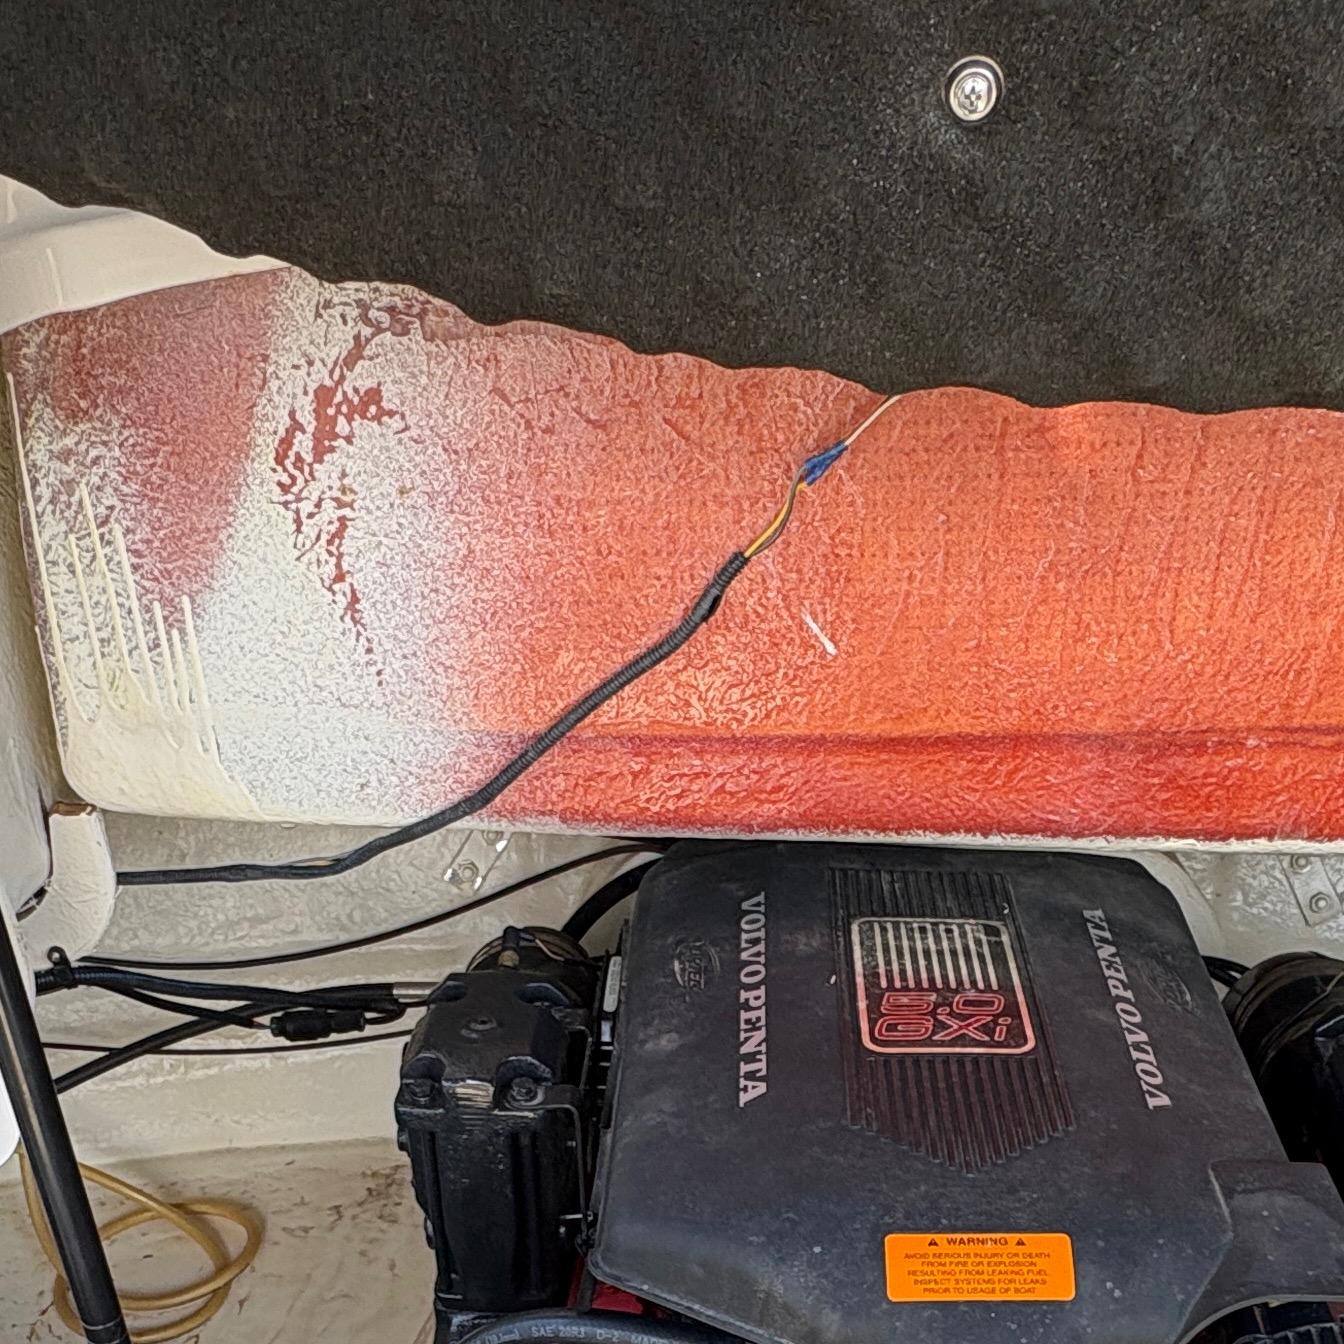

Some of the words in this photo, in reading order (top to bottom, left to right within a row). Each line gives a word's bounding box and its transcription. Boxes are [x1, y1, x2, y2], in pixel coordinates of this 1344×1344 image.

[740, 891, 767, 984] VOLVO
[1082, 908, 1135, 1002] PENTA
[880, 991, 1006, 1015] 5.0
[875, 1015, 1012, 1041] GXi
[739, 985, 768, 1108] PENTA
[1115, 1002, 1173, 1110] VOLVO
[946, 1236, 1009, 1247] WARNING
[904, 1252, 931, 1260] AVOID
[932, 1252, 971, 1260] SERIOUS
[973, 1252, 1004, 1260] INJURY
[1006, 1252, 1020, 1260] OR
[1022, 1252, 1050, 1260] DEATH
[921, 1260, 947, 1268] FROM
[949, 1260, 969, 1268] FIRE
[970, 1260, 984, 1268] OR
[987, 1260, 1037, 1268] EXPLOSION
[907, 1269, 956, 1277] RESULTING
[958, 1269, 985, 1277] FROM
[987, 1269, 1025, 1277] LEAKING
[913, 1278, 951, 1286] INSPECT
[954, 1278, 996, 1286] SYSTEMS
[998, 1278, 1016, 1286] FOR
[923, 1287, 950, 1295] PRIOR
[950, 1287, 965, 1295] TO
[966, 1287, 996, 1295] USAGE
[999, 1287, 1012, 1295] OF
[531, 1326, 556, 1338] SAE
